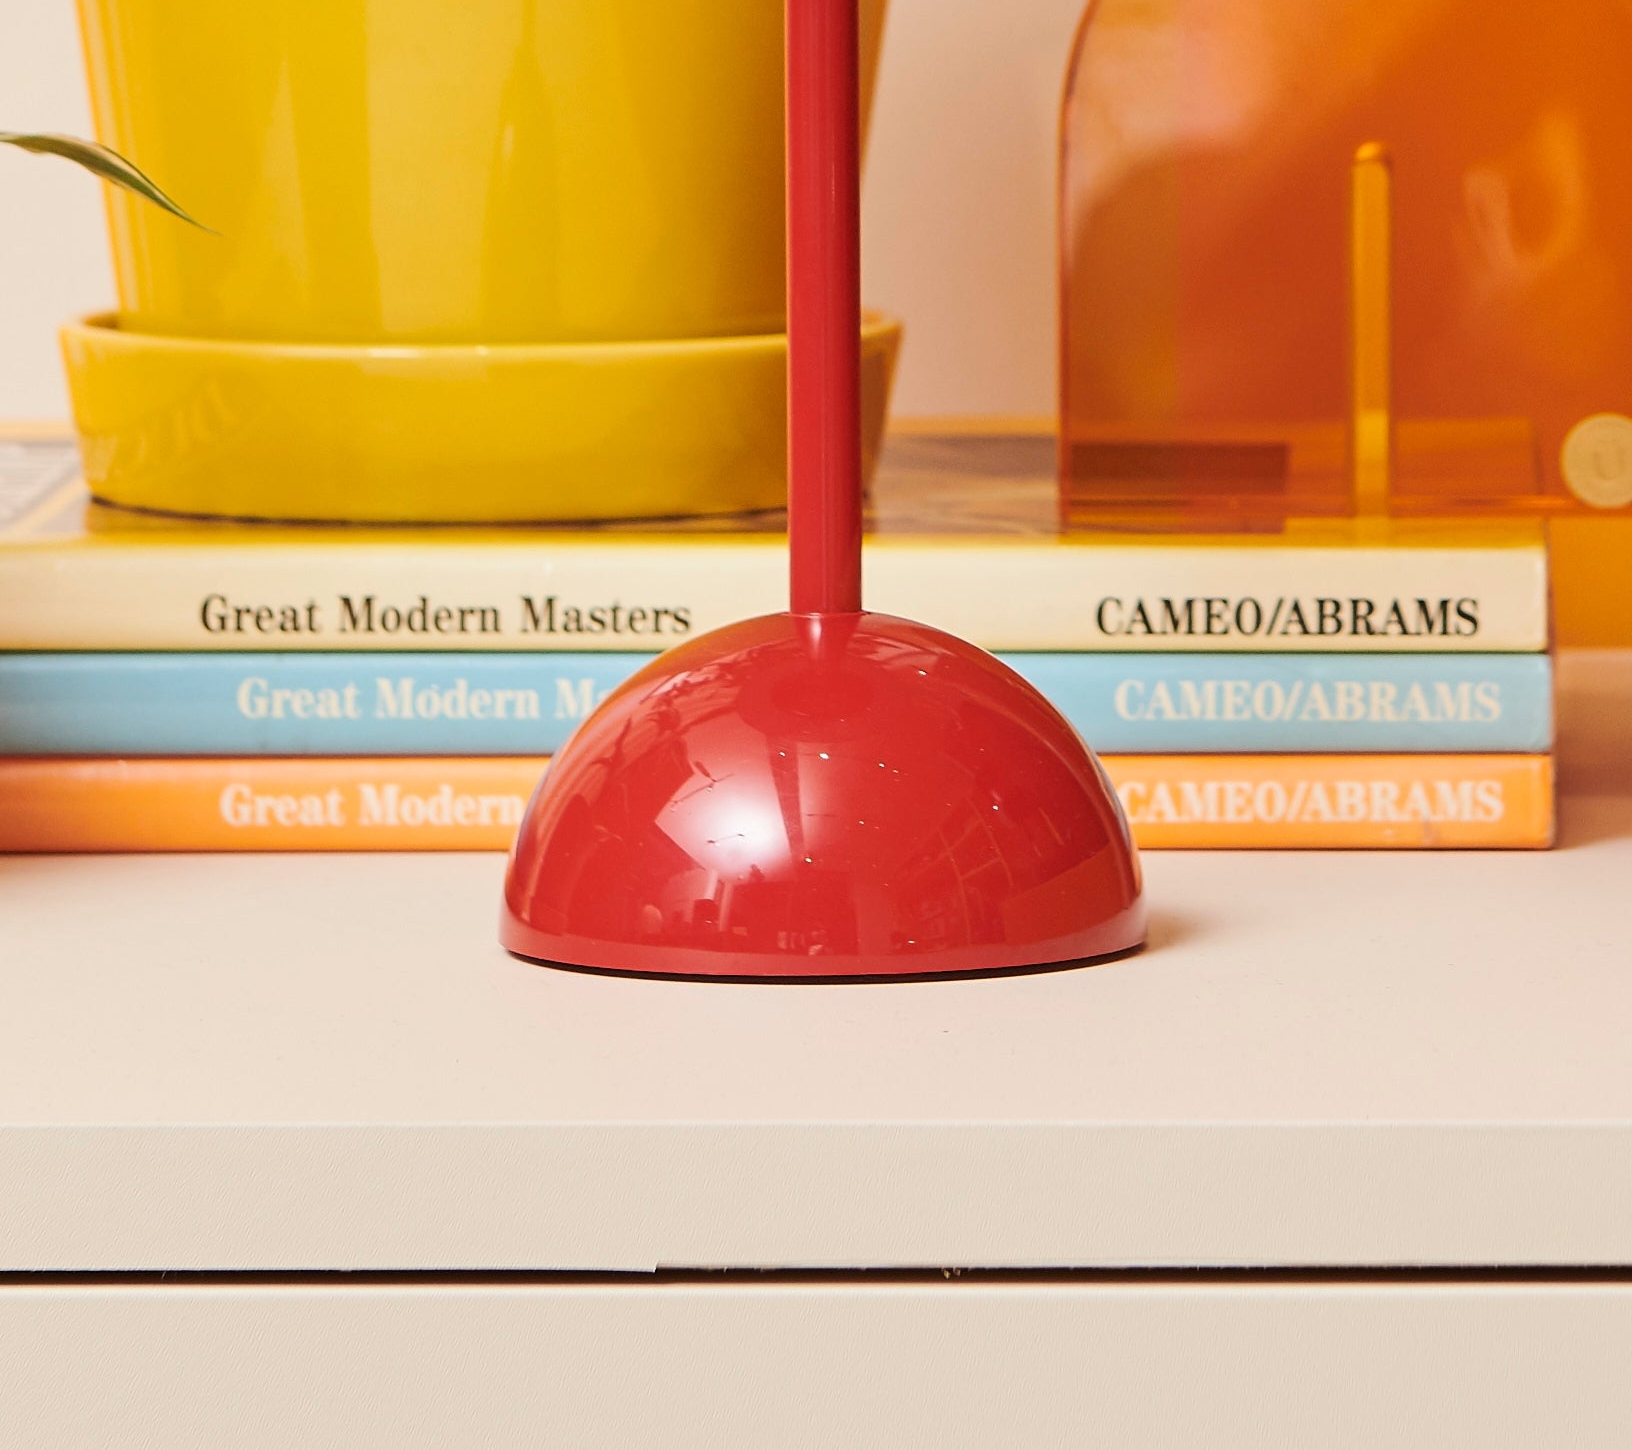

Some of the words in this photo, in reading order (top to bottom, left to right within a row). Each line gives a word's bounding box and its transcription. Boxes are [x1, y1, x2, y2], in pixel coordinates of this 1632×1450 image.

[200, 595, 322, 634] Great
[337, 595, 502, 634] Modern
[520, 596, 691, 634] Masters
[1096, 596, 1479, 637] CAMEO/ABRAMS
[236, 677, 362, 719] Great
[374, 677, 541, 719] Modern
[1114, 680, 1502, 721] CAMEO/ABRAMS
[220, 783, 345, 826] Great
[359, 783, 524, 826] Modern
[1120, 780, 1505, 822] CAMEO/ABRAMS
